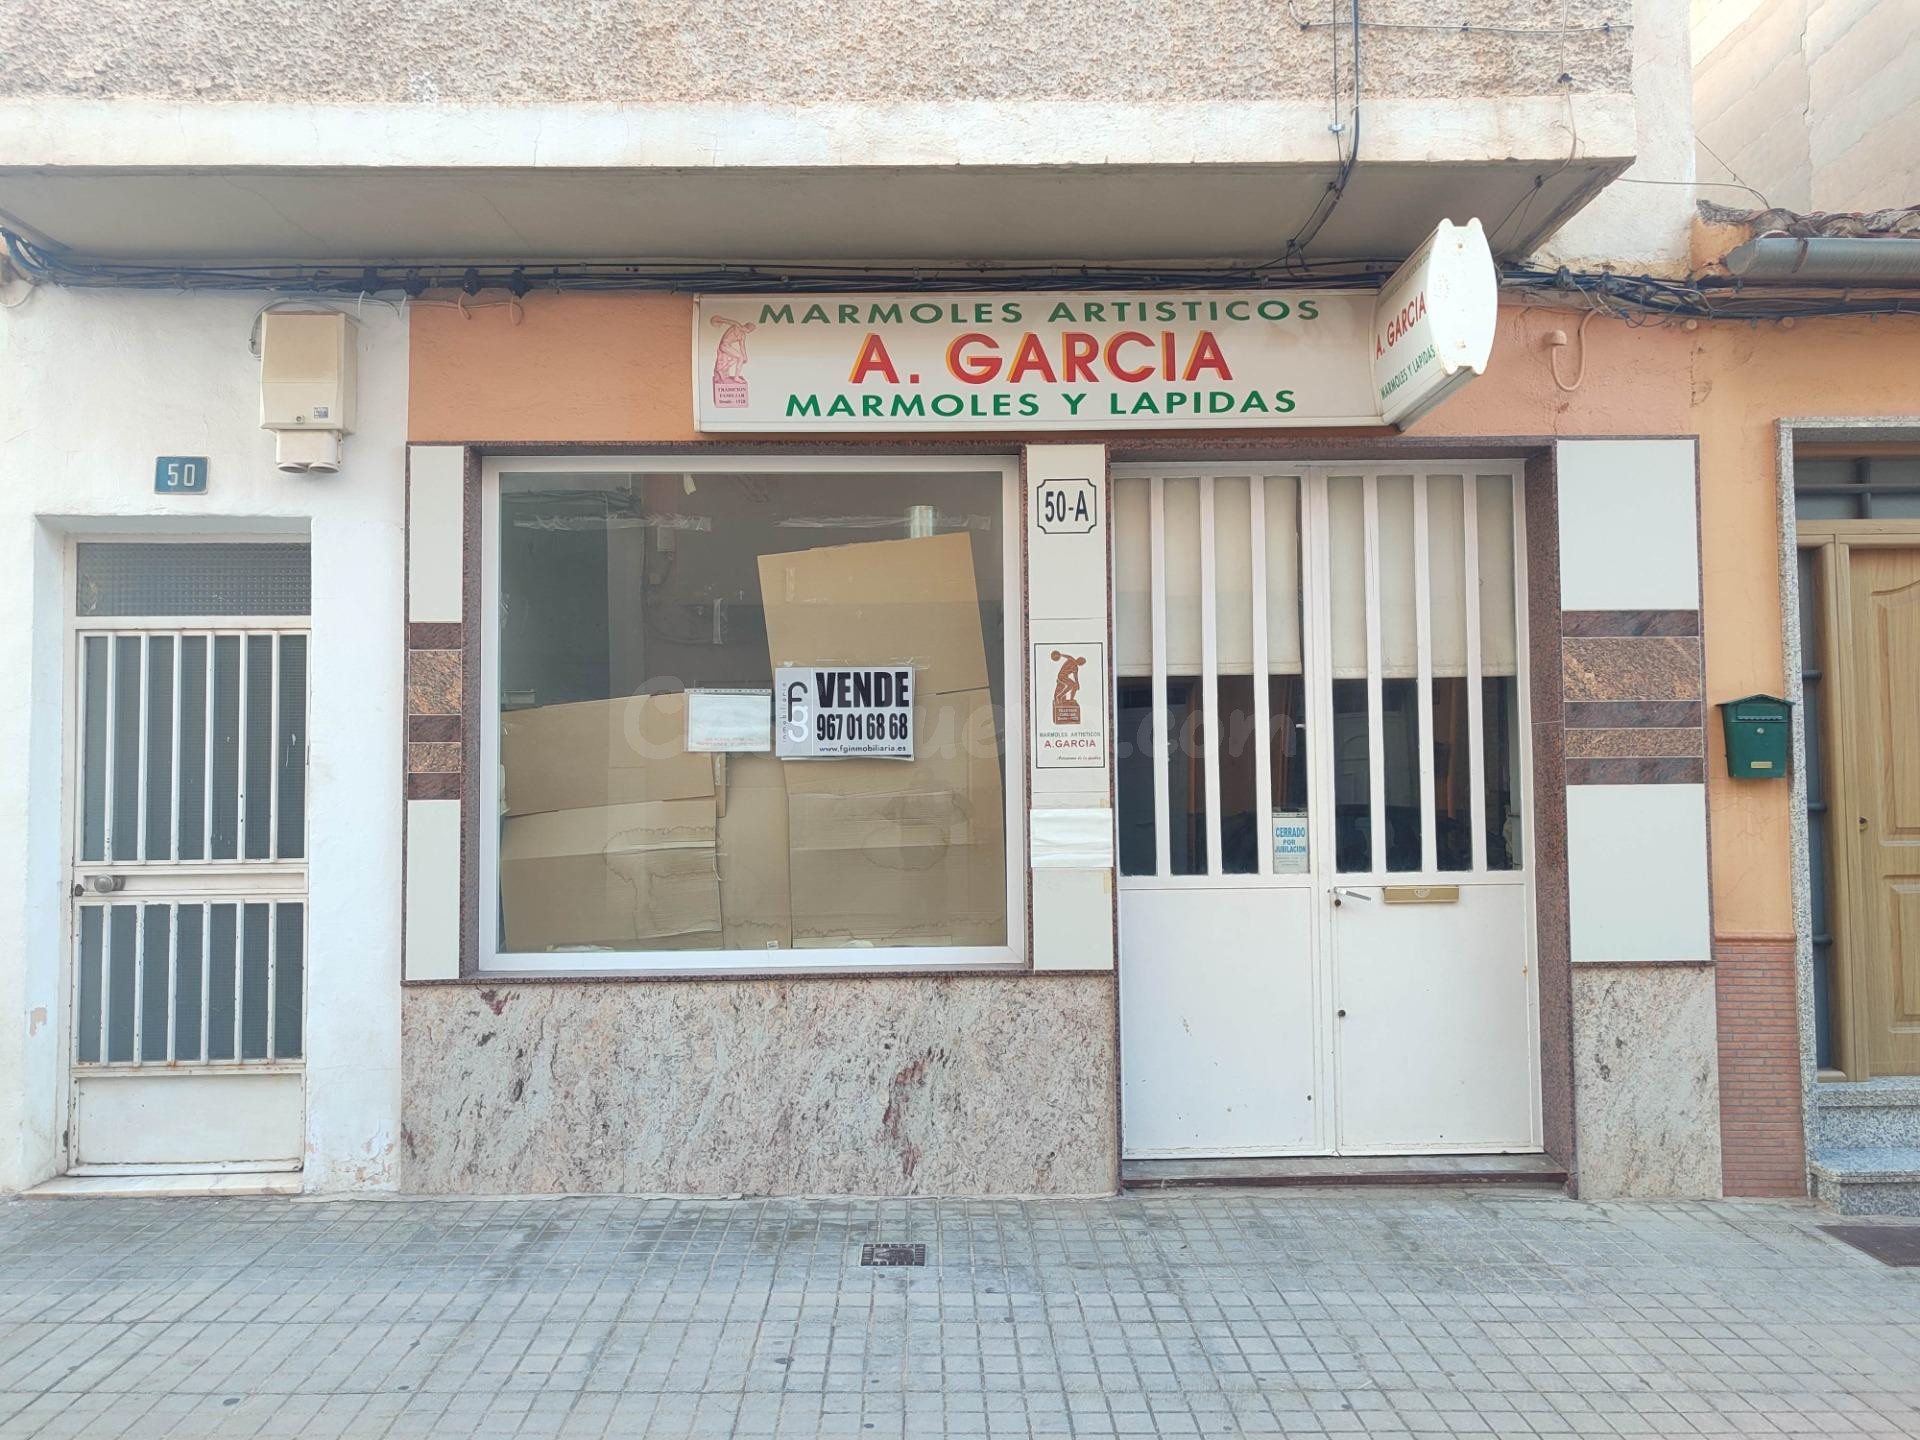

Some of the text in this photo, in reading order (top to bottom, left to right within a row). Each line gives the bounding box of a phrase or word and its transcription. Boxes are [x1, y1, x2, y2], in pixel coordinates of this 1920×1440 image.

[758, 300, 1320, 324] MARMOLES ARTISTICOS
[1386, 291, 1427, 348] GARCIA
[848, 330, 1234, 385] A. GARCIA
[1380, 370, 1409, 401] MARMOLES
[1411, 344, 1436, 373] LAPIDAS
[785, 390, 1296, 418] MARMOLES Y LAPIDAS
[167, 463, 196, 487] 50
[1045, 489, 1090, 523] 50-A
[815, 671, 910, 709] VENDE
[816, 712, 908, 741] 967 01 68 68
[819, 744, 907, 754] www.fginmobiliaria.es
[1275, 826, 1306, 838] CERRADO
